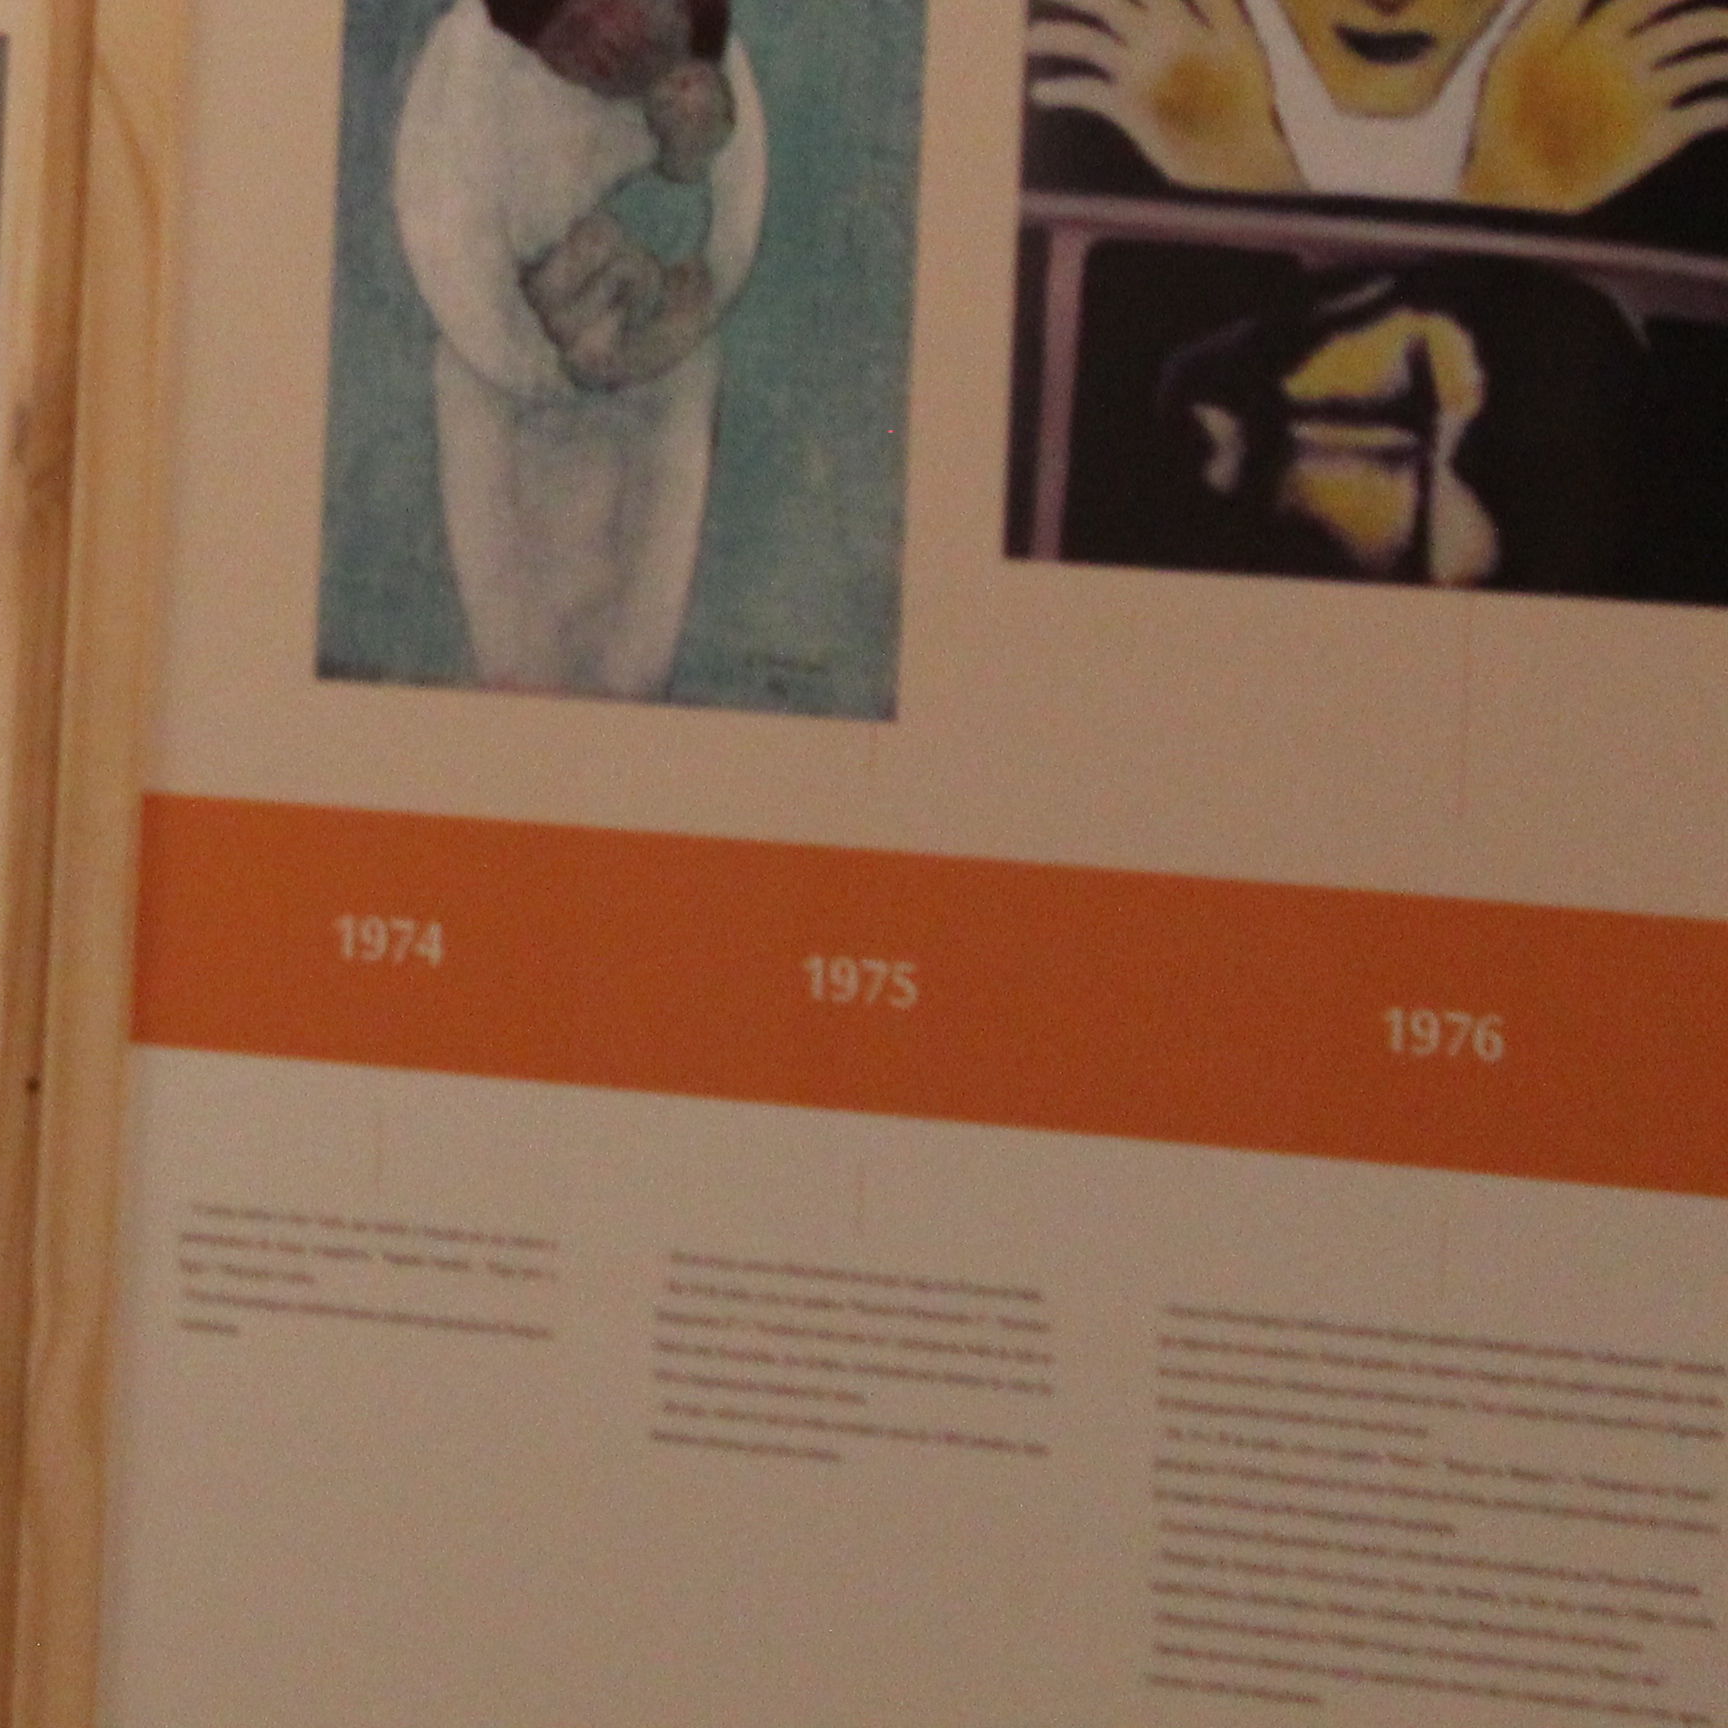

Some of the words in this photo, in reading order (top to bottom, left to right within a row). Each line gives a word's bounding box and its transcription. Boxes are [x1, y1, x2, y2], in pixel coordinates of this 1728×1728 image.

[334, 914, 444, 967] 1974
[802, 954, 919, 1009] 1975
[1383, 1006, 1505, 1063] 1976
